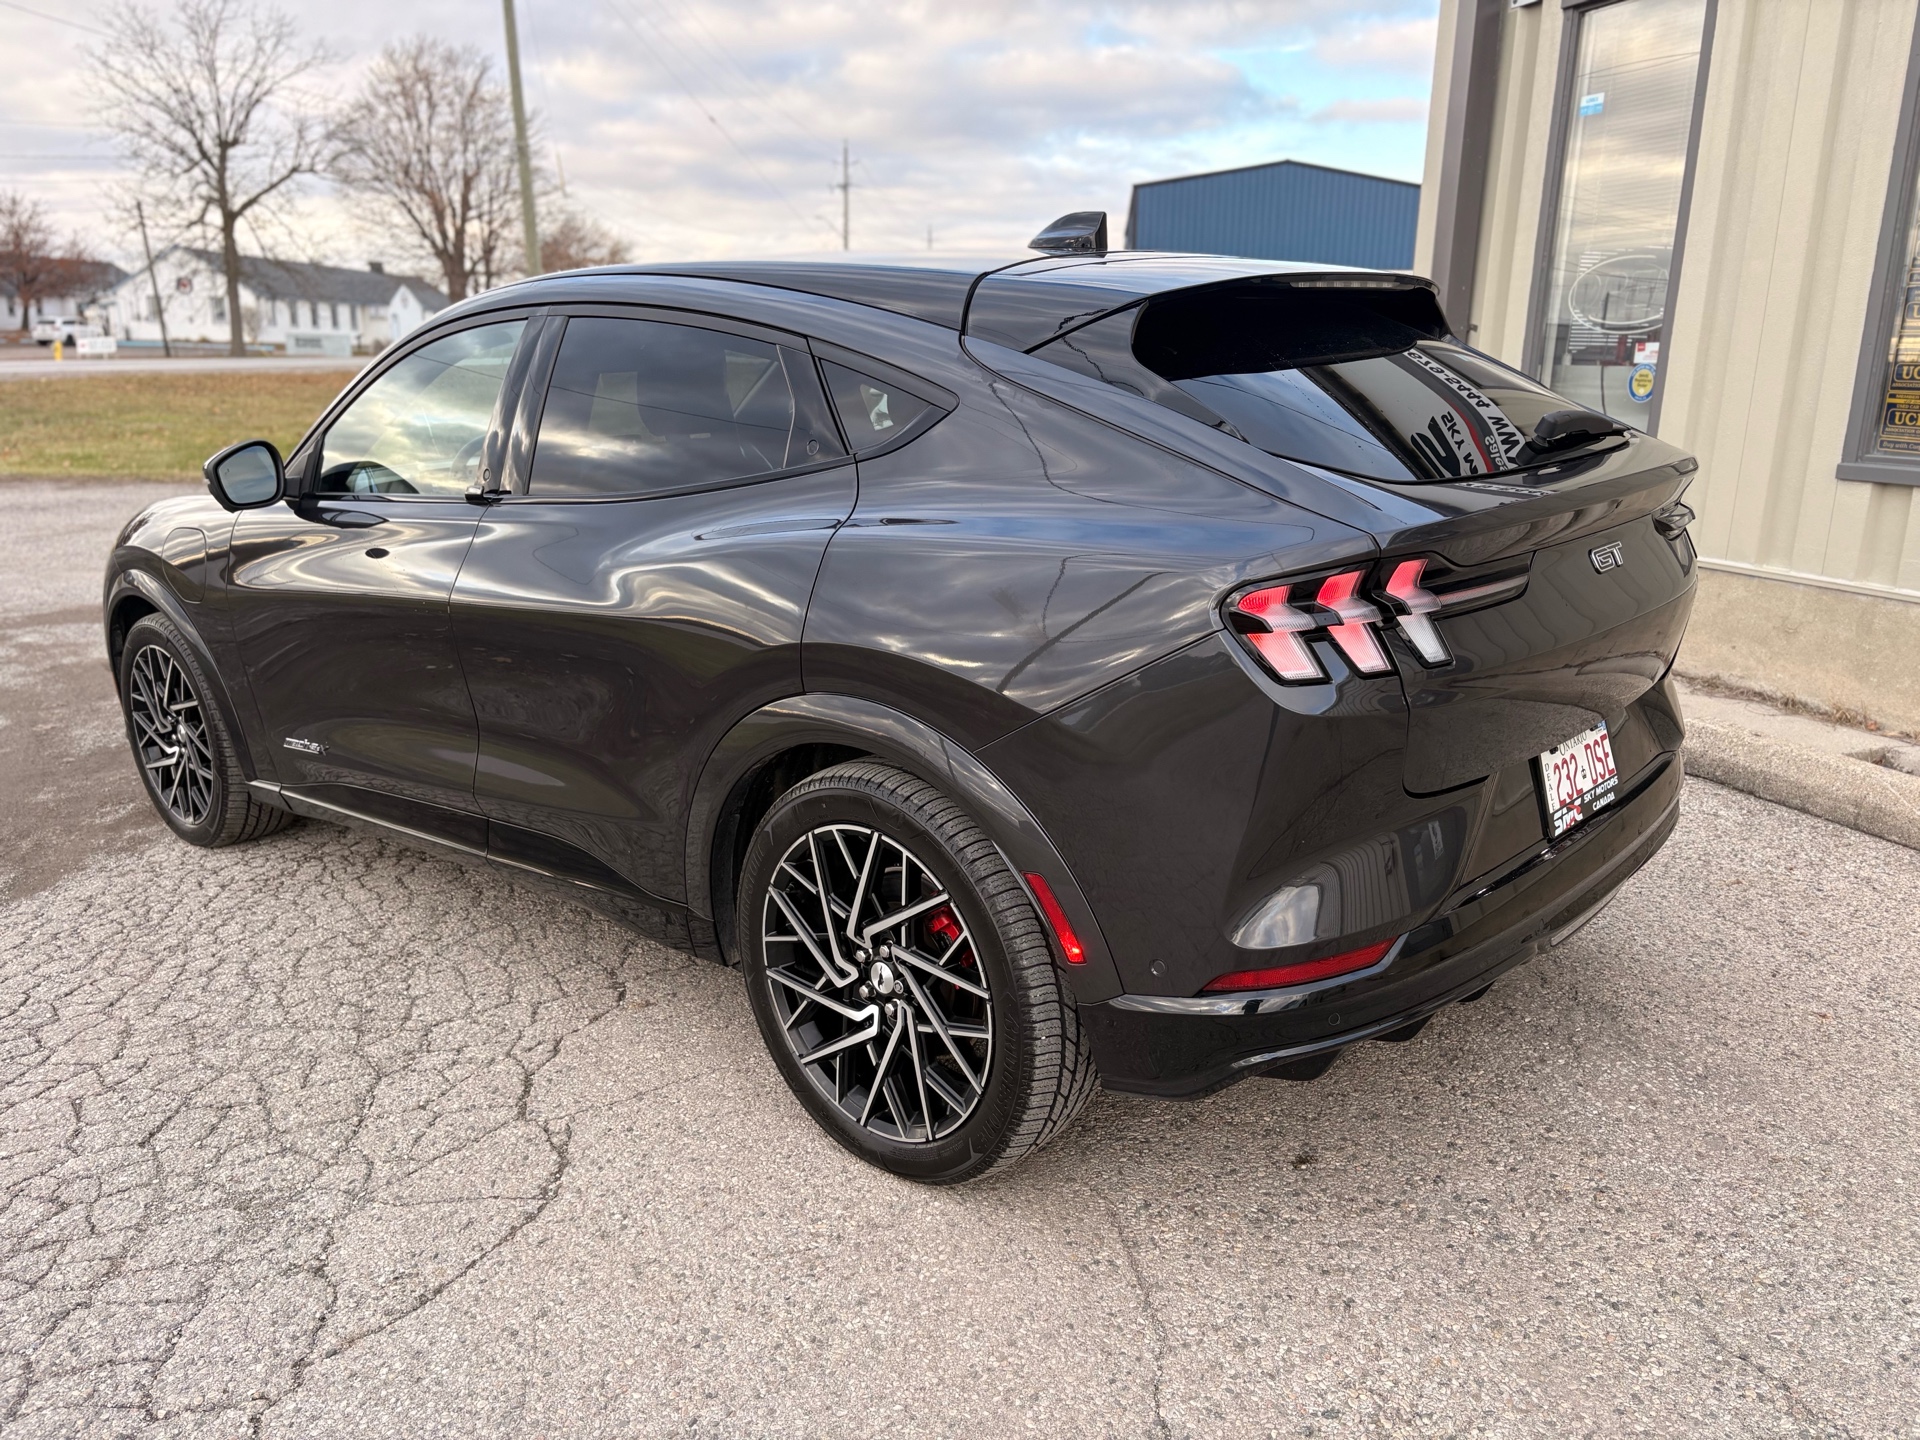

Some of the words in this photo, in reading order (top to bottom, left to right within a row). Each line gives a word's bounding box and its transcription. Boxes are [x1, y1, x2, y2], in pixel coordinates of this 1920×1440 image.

[1589, 541, 1623, 573] GT
[1553, 752, 1583, 806] 232
[1583, 732, 1615, 785] DSE
[1583, 789, 1595, 803] SKY
[1596, 777, 1618, 795] MOTORS
[1592, 791, 1616, 811] CANADA
